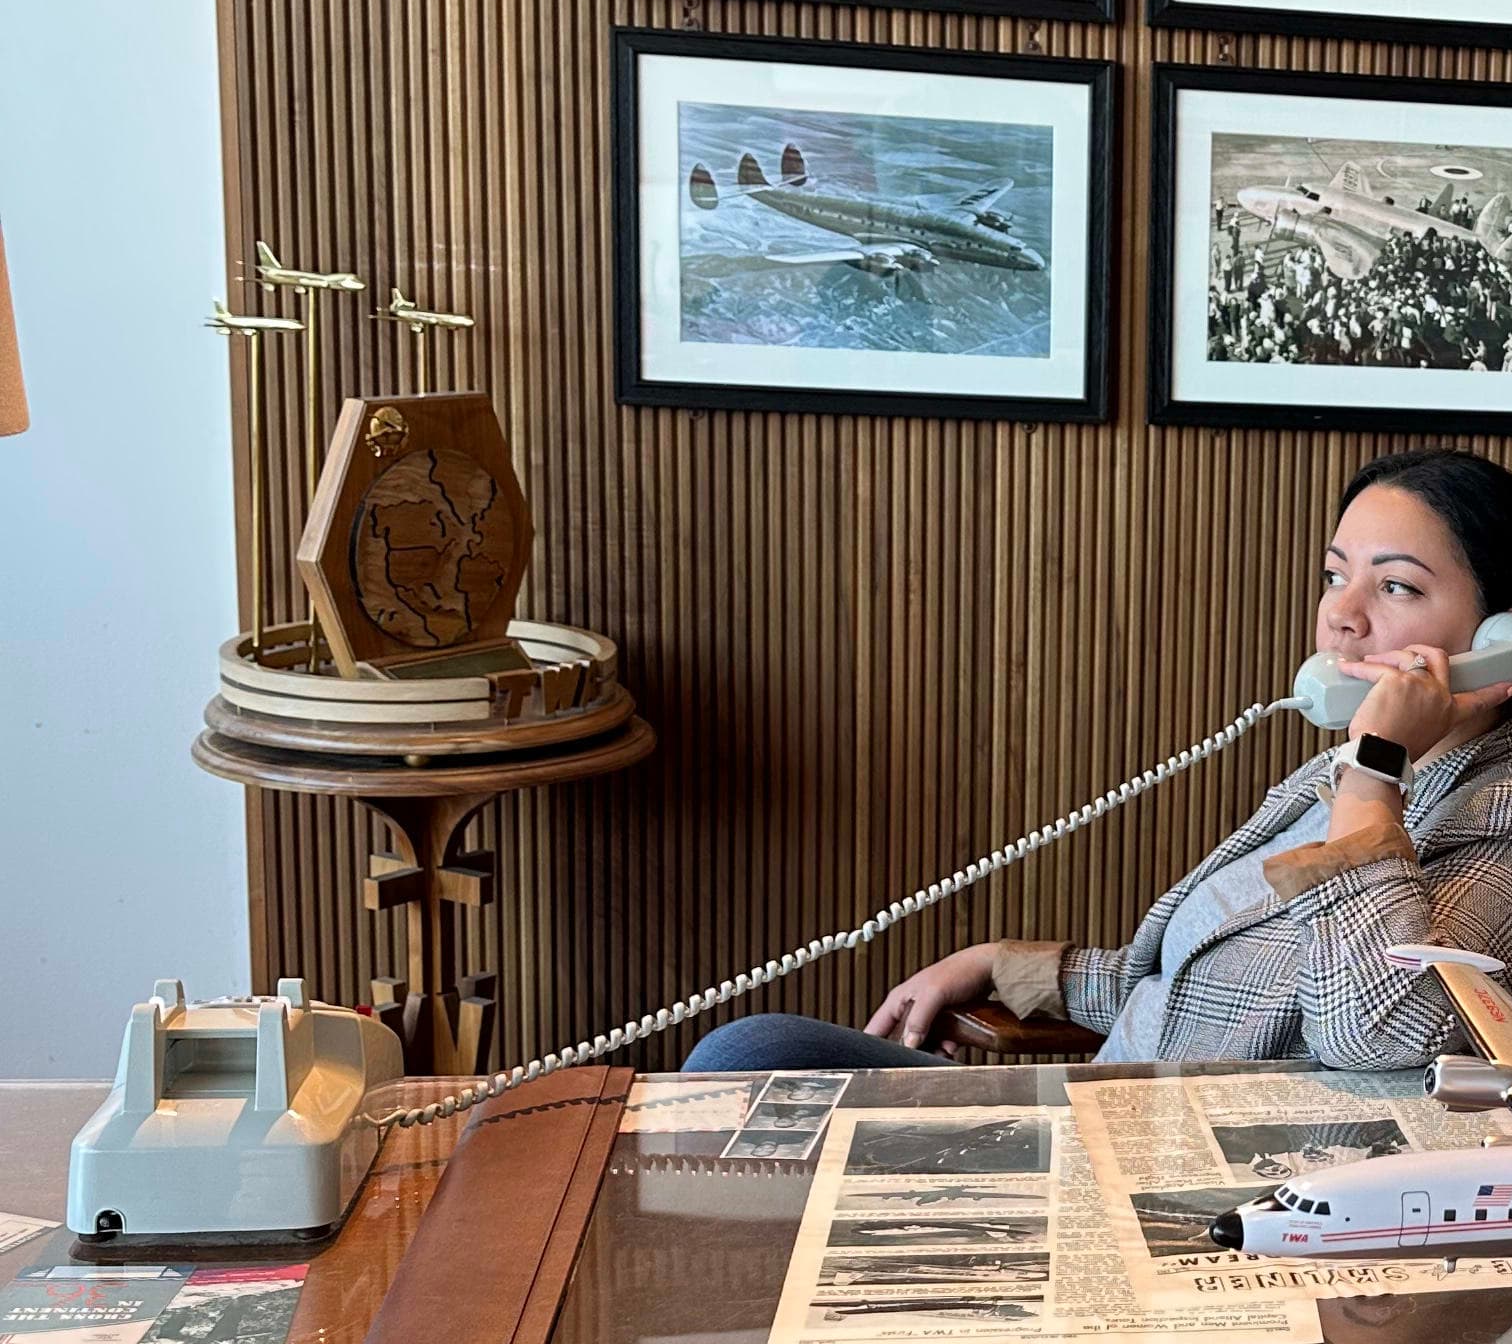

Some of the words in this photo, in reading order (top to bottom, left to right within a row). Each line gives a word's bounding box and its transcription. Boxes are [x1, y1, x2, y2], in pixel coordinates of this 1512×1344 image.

[1281, 1233, 1309, 1243] TWA
[1193, 1266, 1410, 1293] SKYLINER
[118, 1299, 144, 1307] IN
[8, 1306, 138, 1315] CONTINENT
[3, 1313, 48, 1322] THE
[58, 1312, 132, 1321] CROSS
[1231, 1319, 1289, 1327] Prominent
